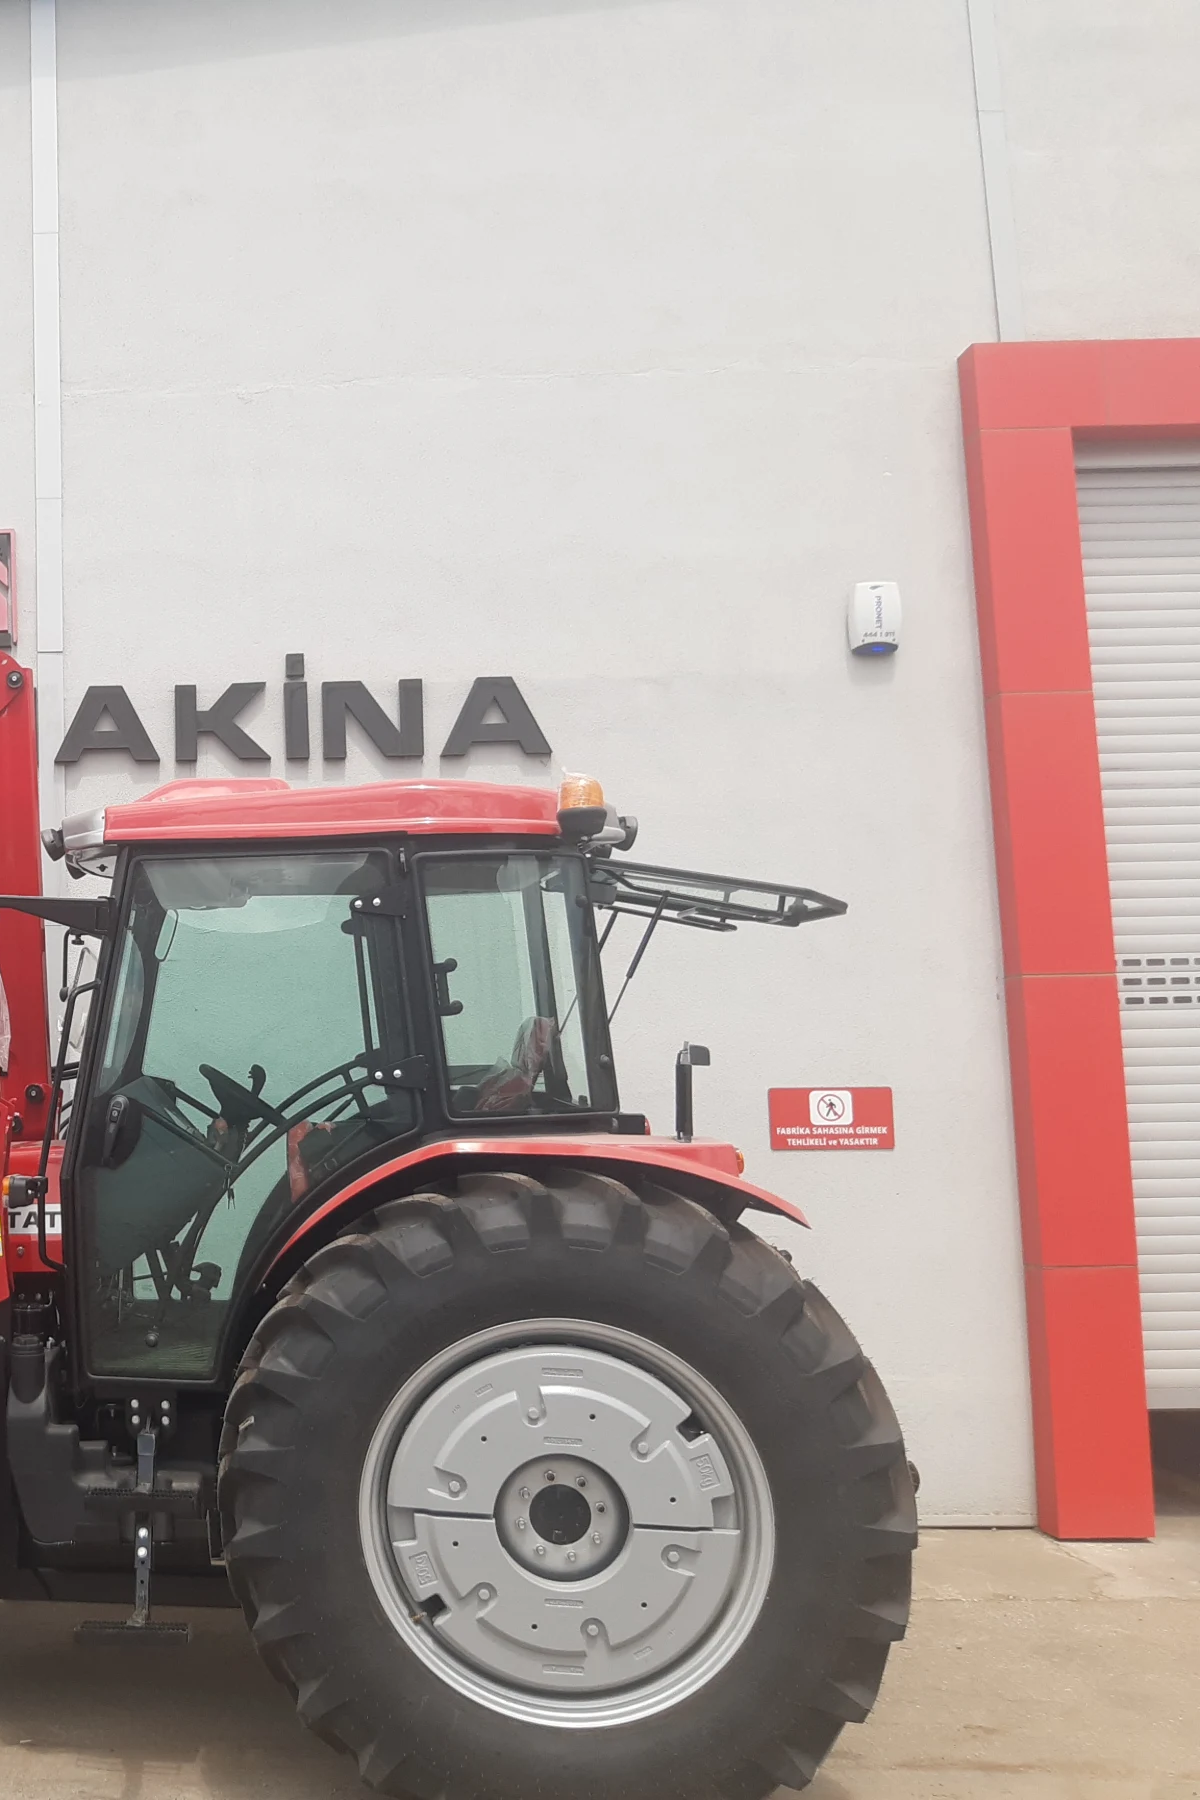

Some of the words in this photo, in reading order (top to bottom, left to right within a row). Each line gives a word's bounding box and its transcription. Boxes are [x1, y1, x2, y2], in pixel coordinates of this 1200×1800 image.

[875, 595, 883, 629] PRONET
[54, 652, 553, 763] AKİNA
[776, 1126, 810, 1135] FABRİKA
[812, 1126, 854, 1135] SAHASINA
[856, 1125, 888, 1134] GİRMEK
[787, 1137, 826, 1146] TEHLİKELİ
[839, 1137, 878, 1146] YASAKTIR
[8, 1211, 61, 1228] TAT
